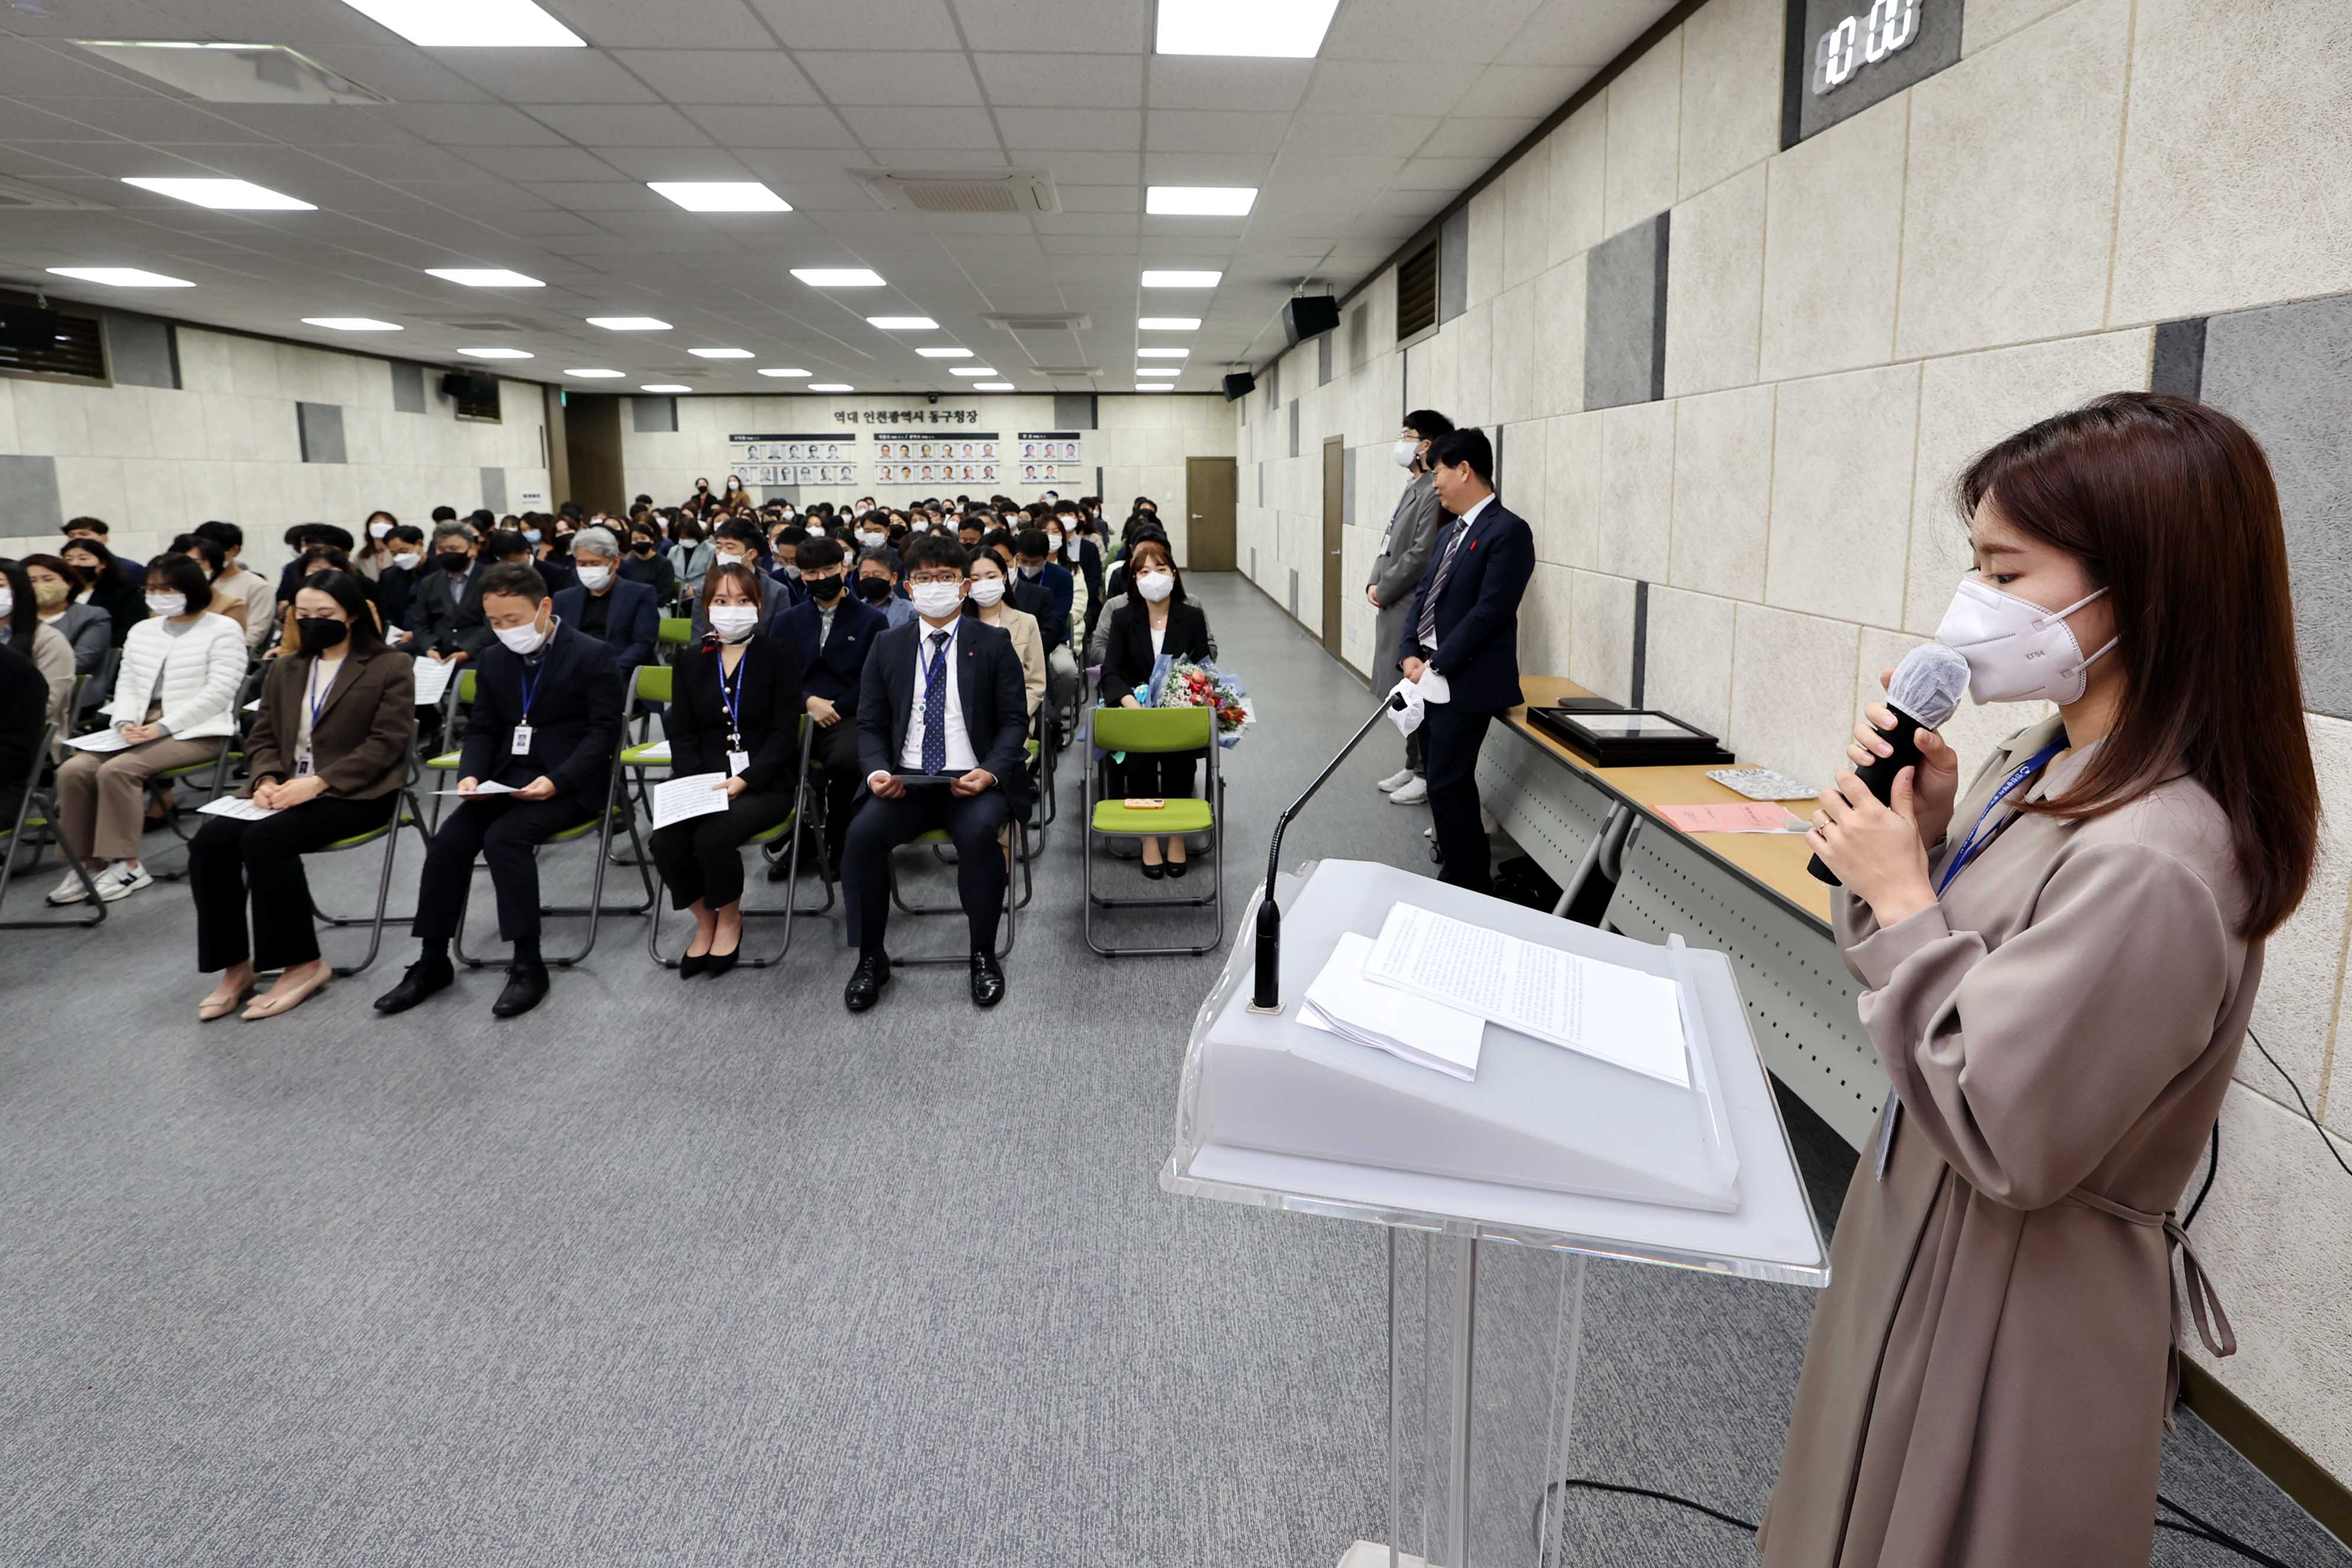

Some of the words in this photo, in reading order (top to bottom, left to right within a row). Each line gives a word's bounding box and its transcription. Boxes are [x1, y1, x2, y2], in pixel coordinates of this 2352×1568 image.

[834, 410, 858, 424] 역대
[864, 410, 924, 424] 인천광역시
[928, 410, 978, 424] 동구청장
[2026, 650, 2046, 661] KF94
